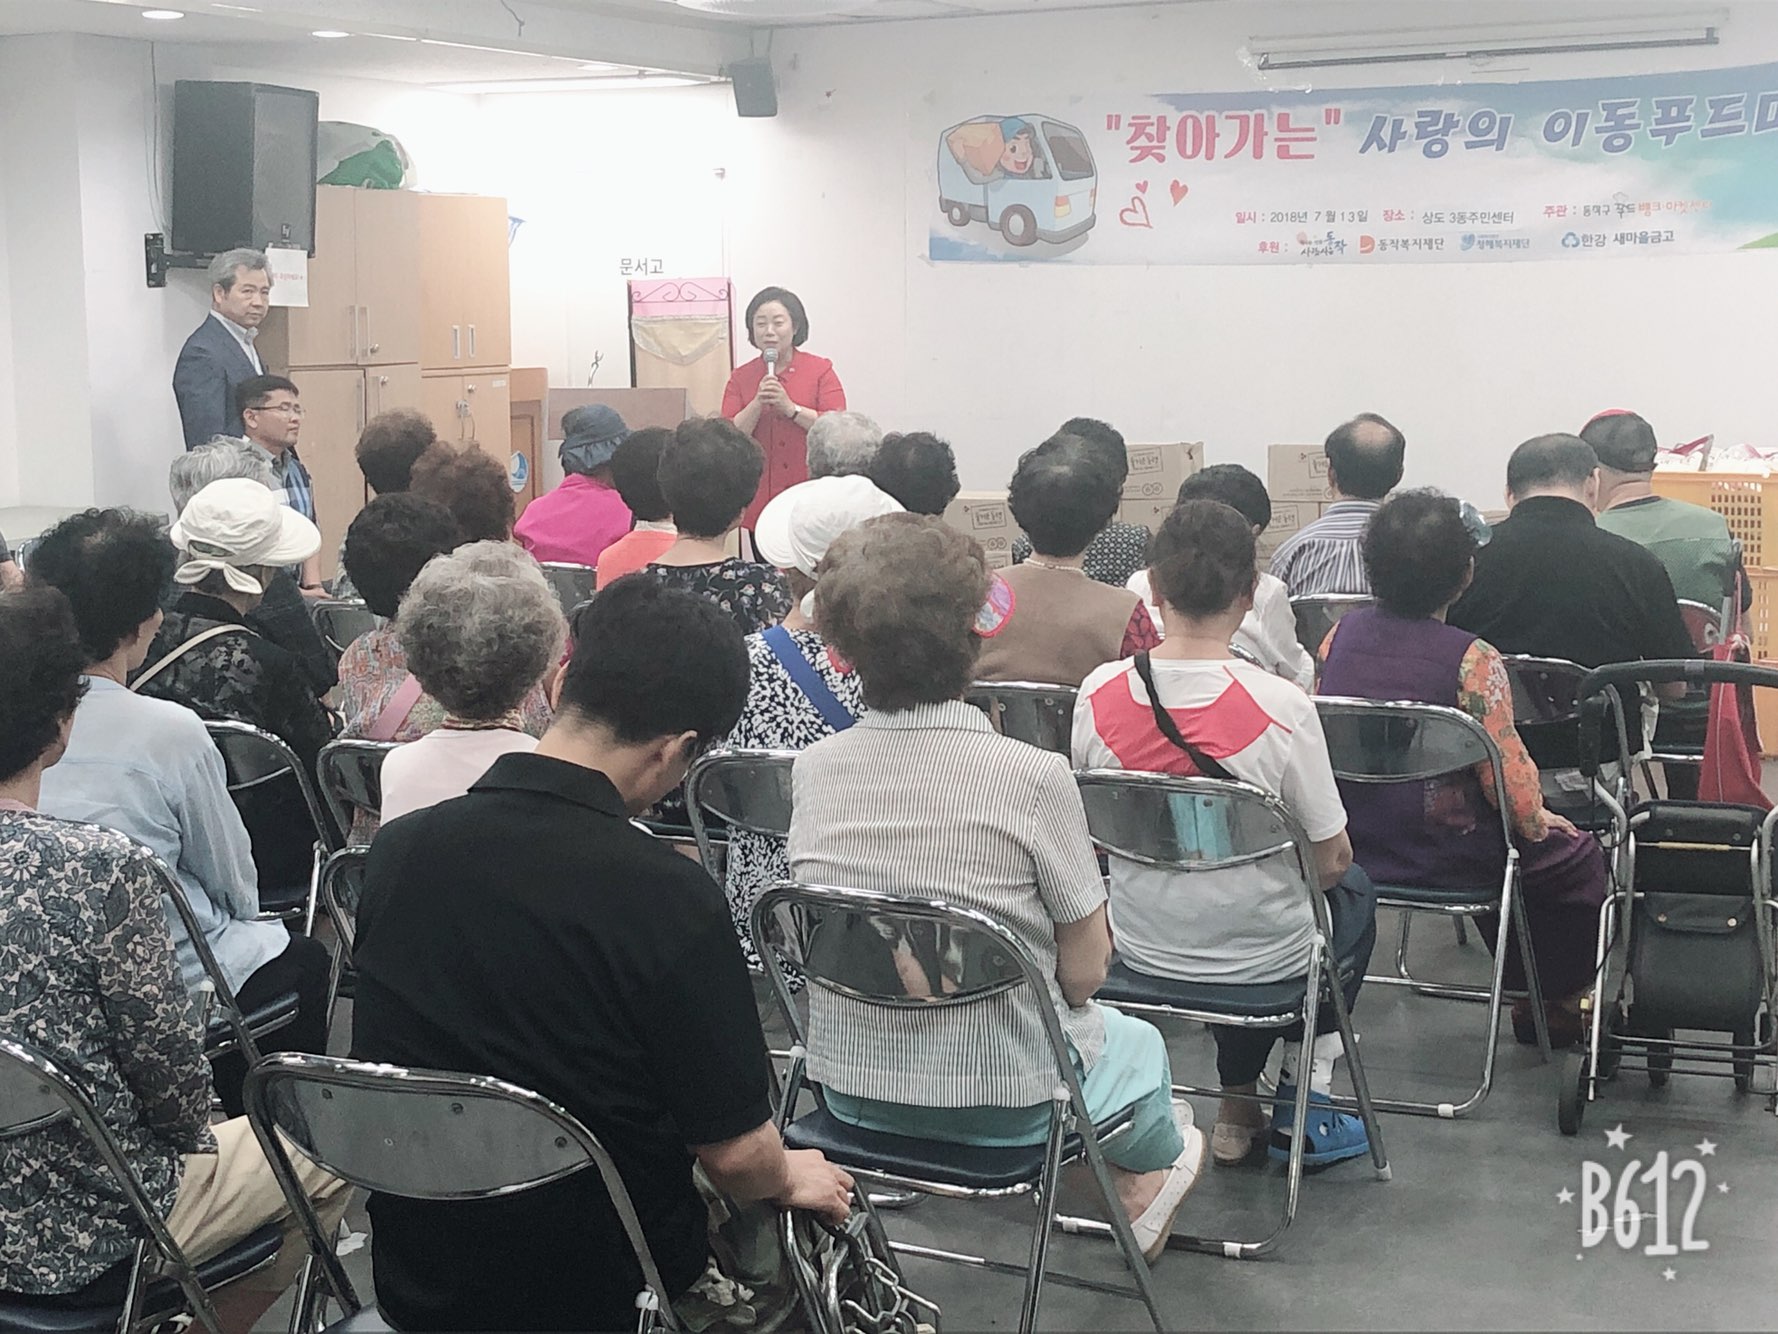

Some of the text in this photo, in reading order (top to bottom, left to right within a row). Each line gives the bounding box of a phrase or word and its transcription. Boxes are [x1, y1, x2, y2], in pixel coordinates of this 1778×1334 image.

[1106, 108, 1341, 163] "찾아가는"
[1358, 109, 1514, 159] 사랑의
[1270, 211, 1308, 223] 2018년
[1377, 237, 1445, 250] 동작복지재단
[1613, 230, 1675, 245] 새마을금고
[619, 257, 664, 276] 문서고
